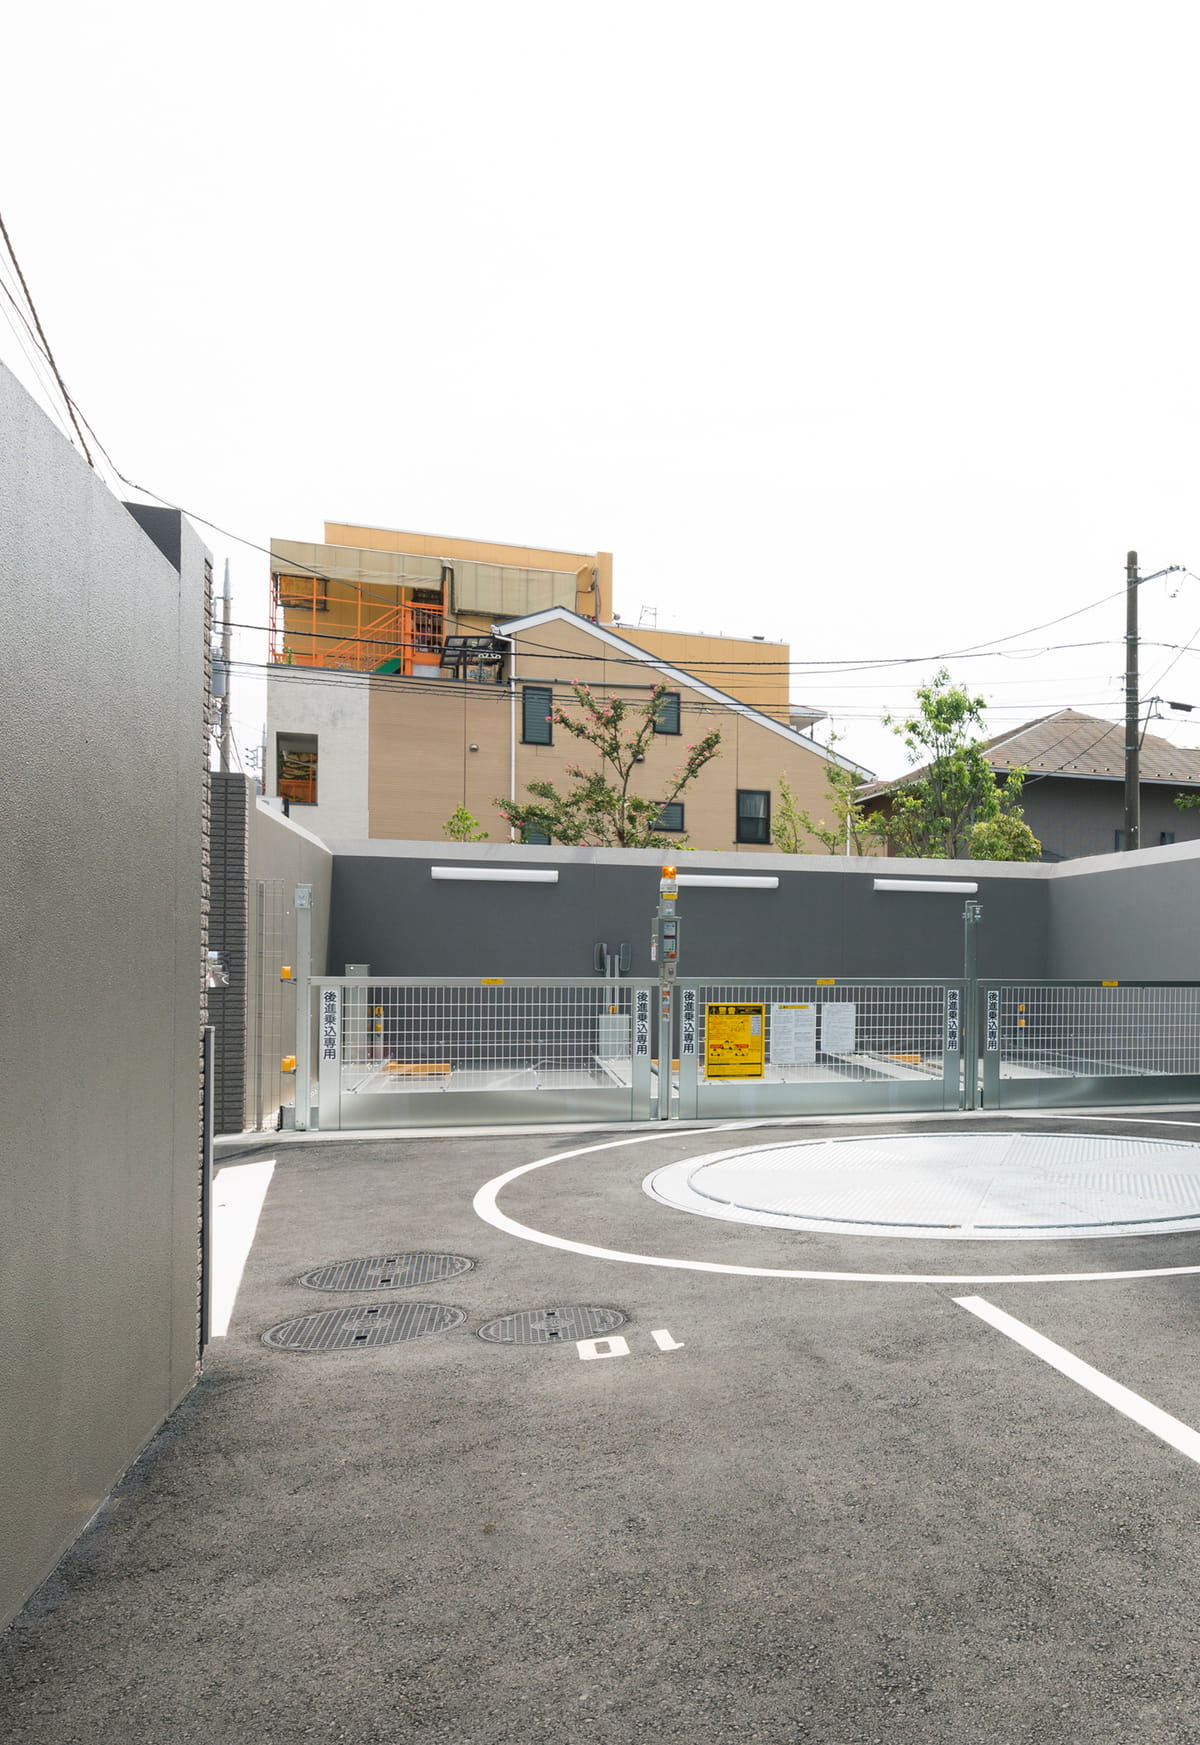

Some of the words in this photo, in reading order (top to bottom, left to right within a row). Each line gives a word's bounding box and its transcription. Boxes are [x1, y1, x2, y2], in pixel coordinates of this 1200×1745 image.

[323, 991, 337, 1060] 後進乗込専用
[636, 991, 649, 1056] 後進乗込専用
[683, 991, 695, 1055] 後進乗込専用
